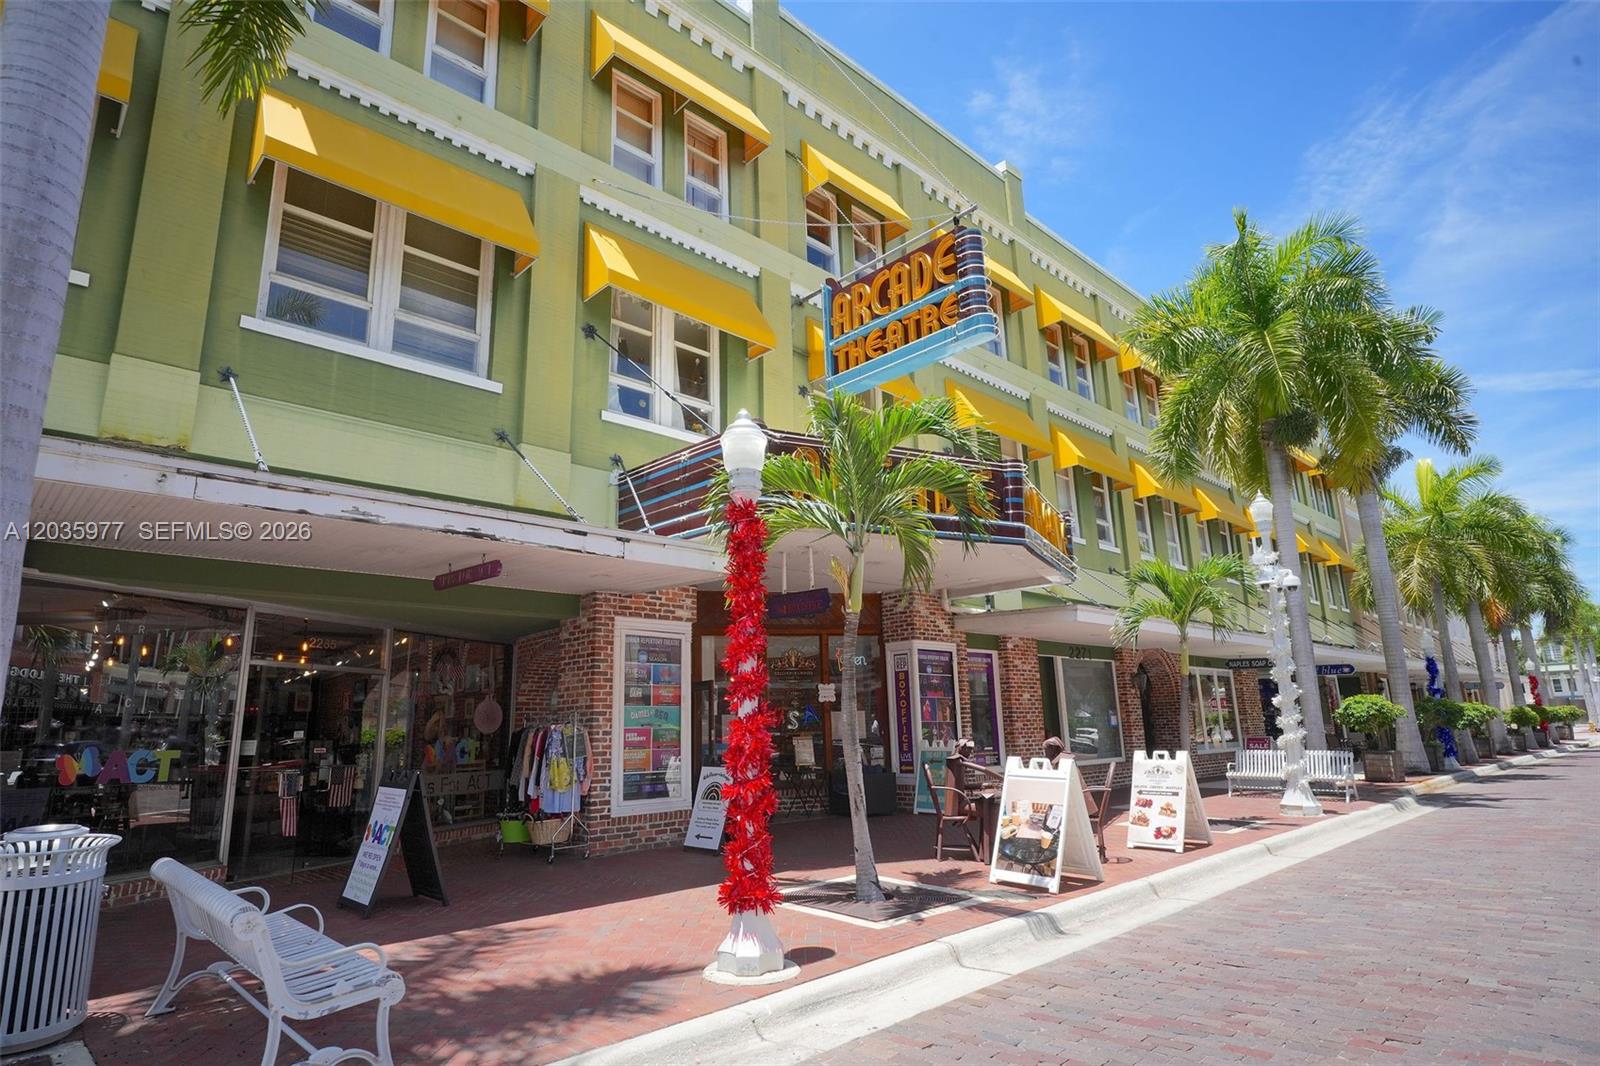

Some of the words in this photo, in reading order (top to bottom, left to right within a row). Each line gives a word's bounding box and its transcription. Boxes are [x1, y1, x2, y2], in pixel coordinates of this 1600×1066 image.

[831, 233, 957, 339] ARCADE
[833, 292, 958, 374] THEATRE
[900, 700, 909, 752] OFFICE
[95, 748, 182, 784] ACT
[371, 823, 397, 848] ACT
